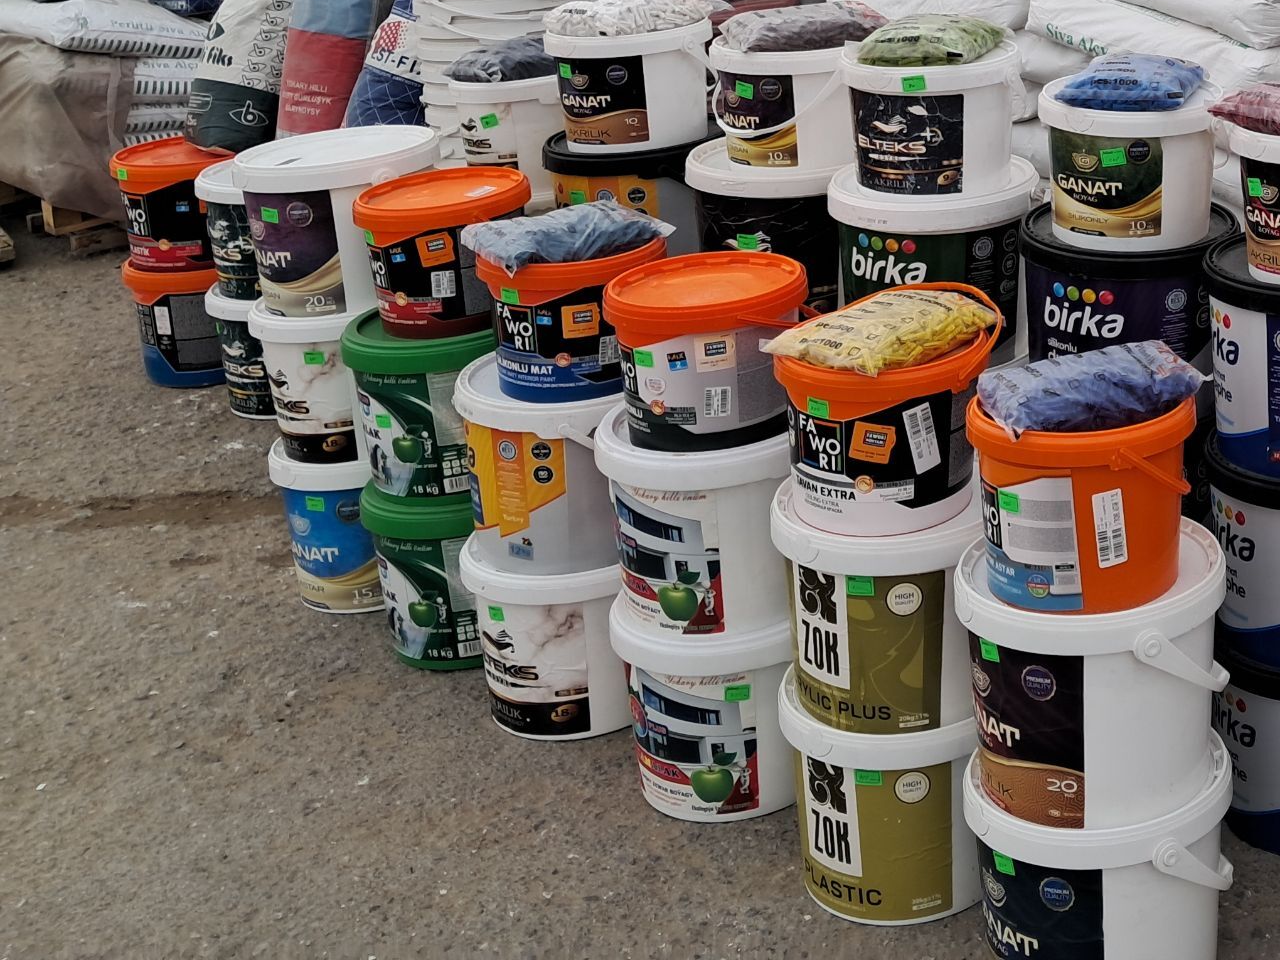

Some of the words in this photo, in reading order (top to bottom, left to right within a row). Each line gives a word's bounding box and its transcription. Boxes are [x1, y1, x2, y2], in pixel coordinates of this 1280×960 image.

[1045, 21, 1075, 46] Siva
[562, 92, 611, 109] GANAT
[624, 117, 638, 126] 10
[858, 132, 927, 155] ELTEKS
[767, 151, 784, 161] 10
[1057, 173, 1123, 197] GANAT
[1129, 220, 1147, 231] 10
[851, 246, 928, 285] birka
[304, 295, 325, 308] 20
[496, 302, 512, 320] FA
[1043, 297, 1125, 339] birka
[504, 320, 533, 337] WO
[514, 337, 530, 351] RI
[530, 365, 554, 375] MAT
[799, 413, 817, 433] FA
[324, 438, 339, 448] 18
[808, 437, 841, 456] WO
[818, 454, 840, 472] RI
[412, 485, 424, 494] 18
[820, 486, 857, 502] EXTRA
[352, 588, 373, 601] 15
[894, 592, 915, 601] HIGH
[427, 648, 439, 658] 18
[801, 618, 840, 677] ZOK
[837, 700, 892, 721] PLUS
[902, 779, 922, 789] HIGH
[1046, 778, 1078, 794] 20
[811, 807, 852, 865] ZOK
[804, 857, 883, 906] PLASTIC
[1043, 885, 1070, 896] PREMIUM
